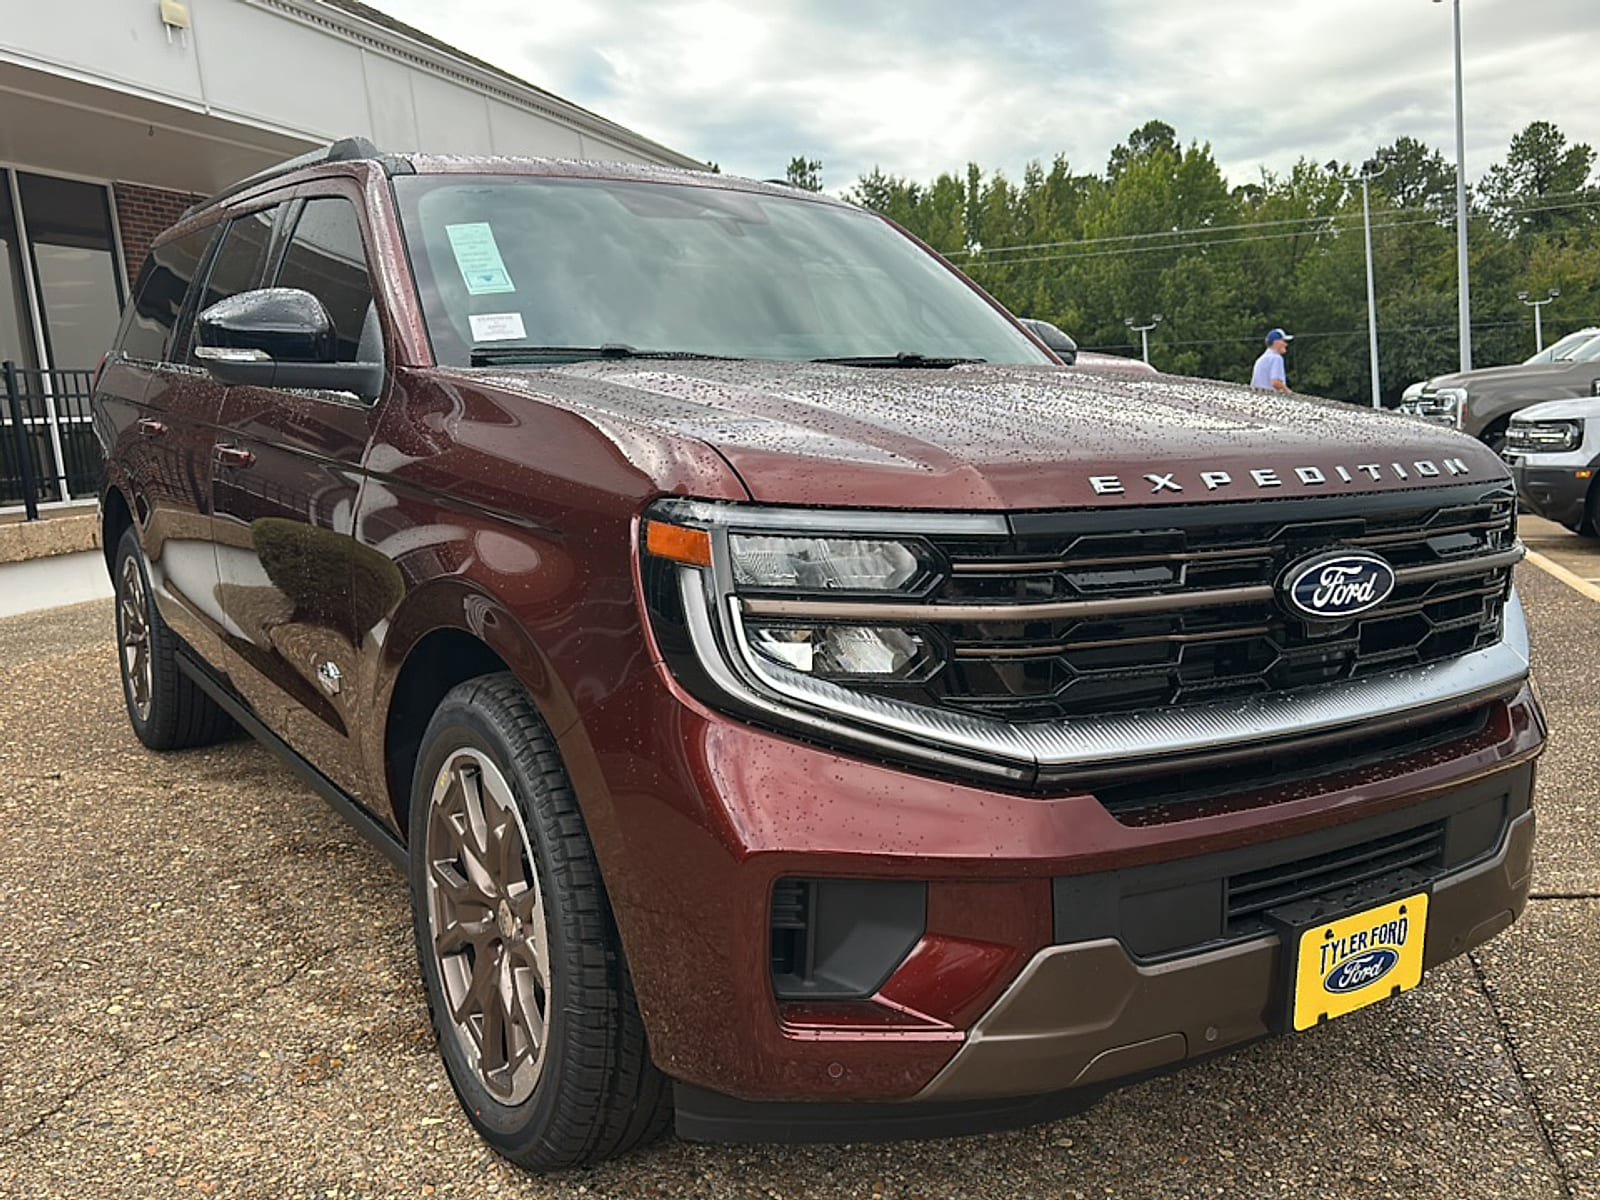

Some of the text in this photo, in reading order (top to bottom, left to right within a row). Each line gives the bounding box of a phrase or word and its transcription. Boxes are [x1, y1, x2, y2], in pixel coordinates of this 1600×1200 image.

[1088, 457, 1471, 496] EXPEDITION
[1313, 565, 1377, 609] Ford
[1320, 918, 1408, 976] TYLER FORD
[1338, 955, 1385, 988] Ford
